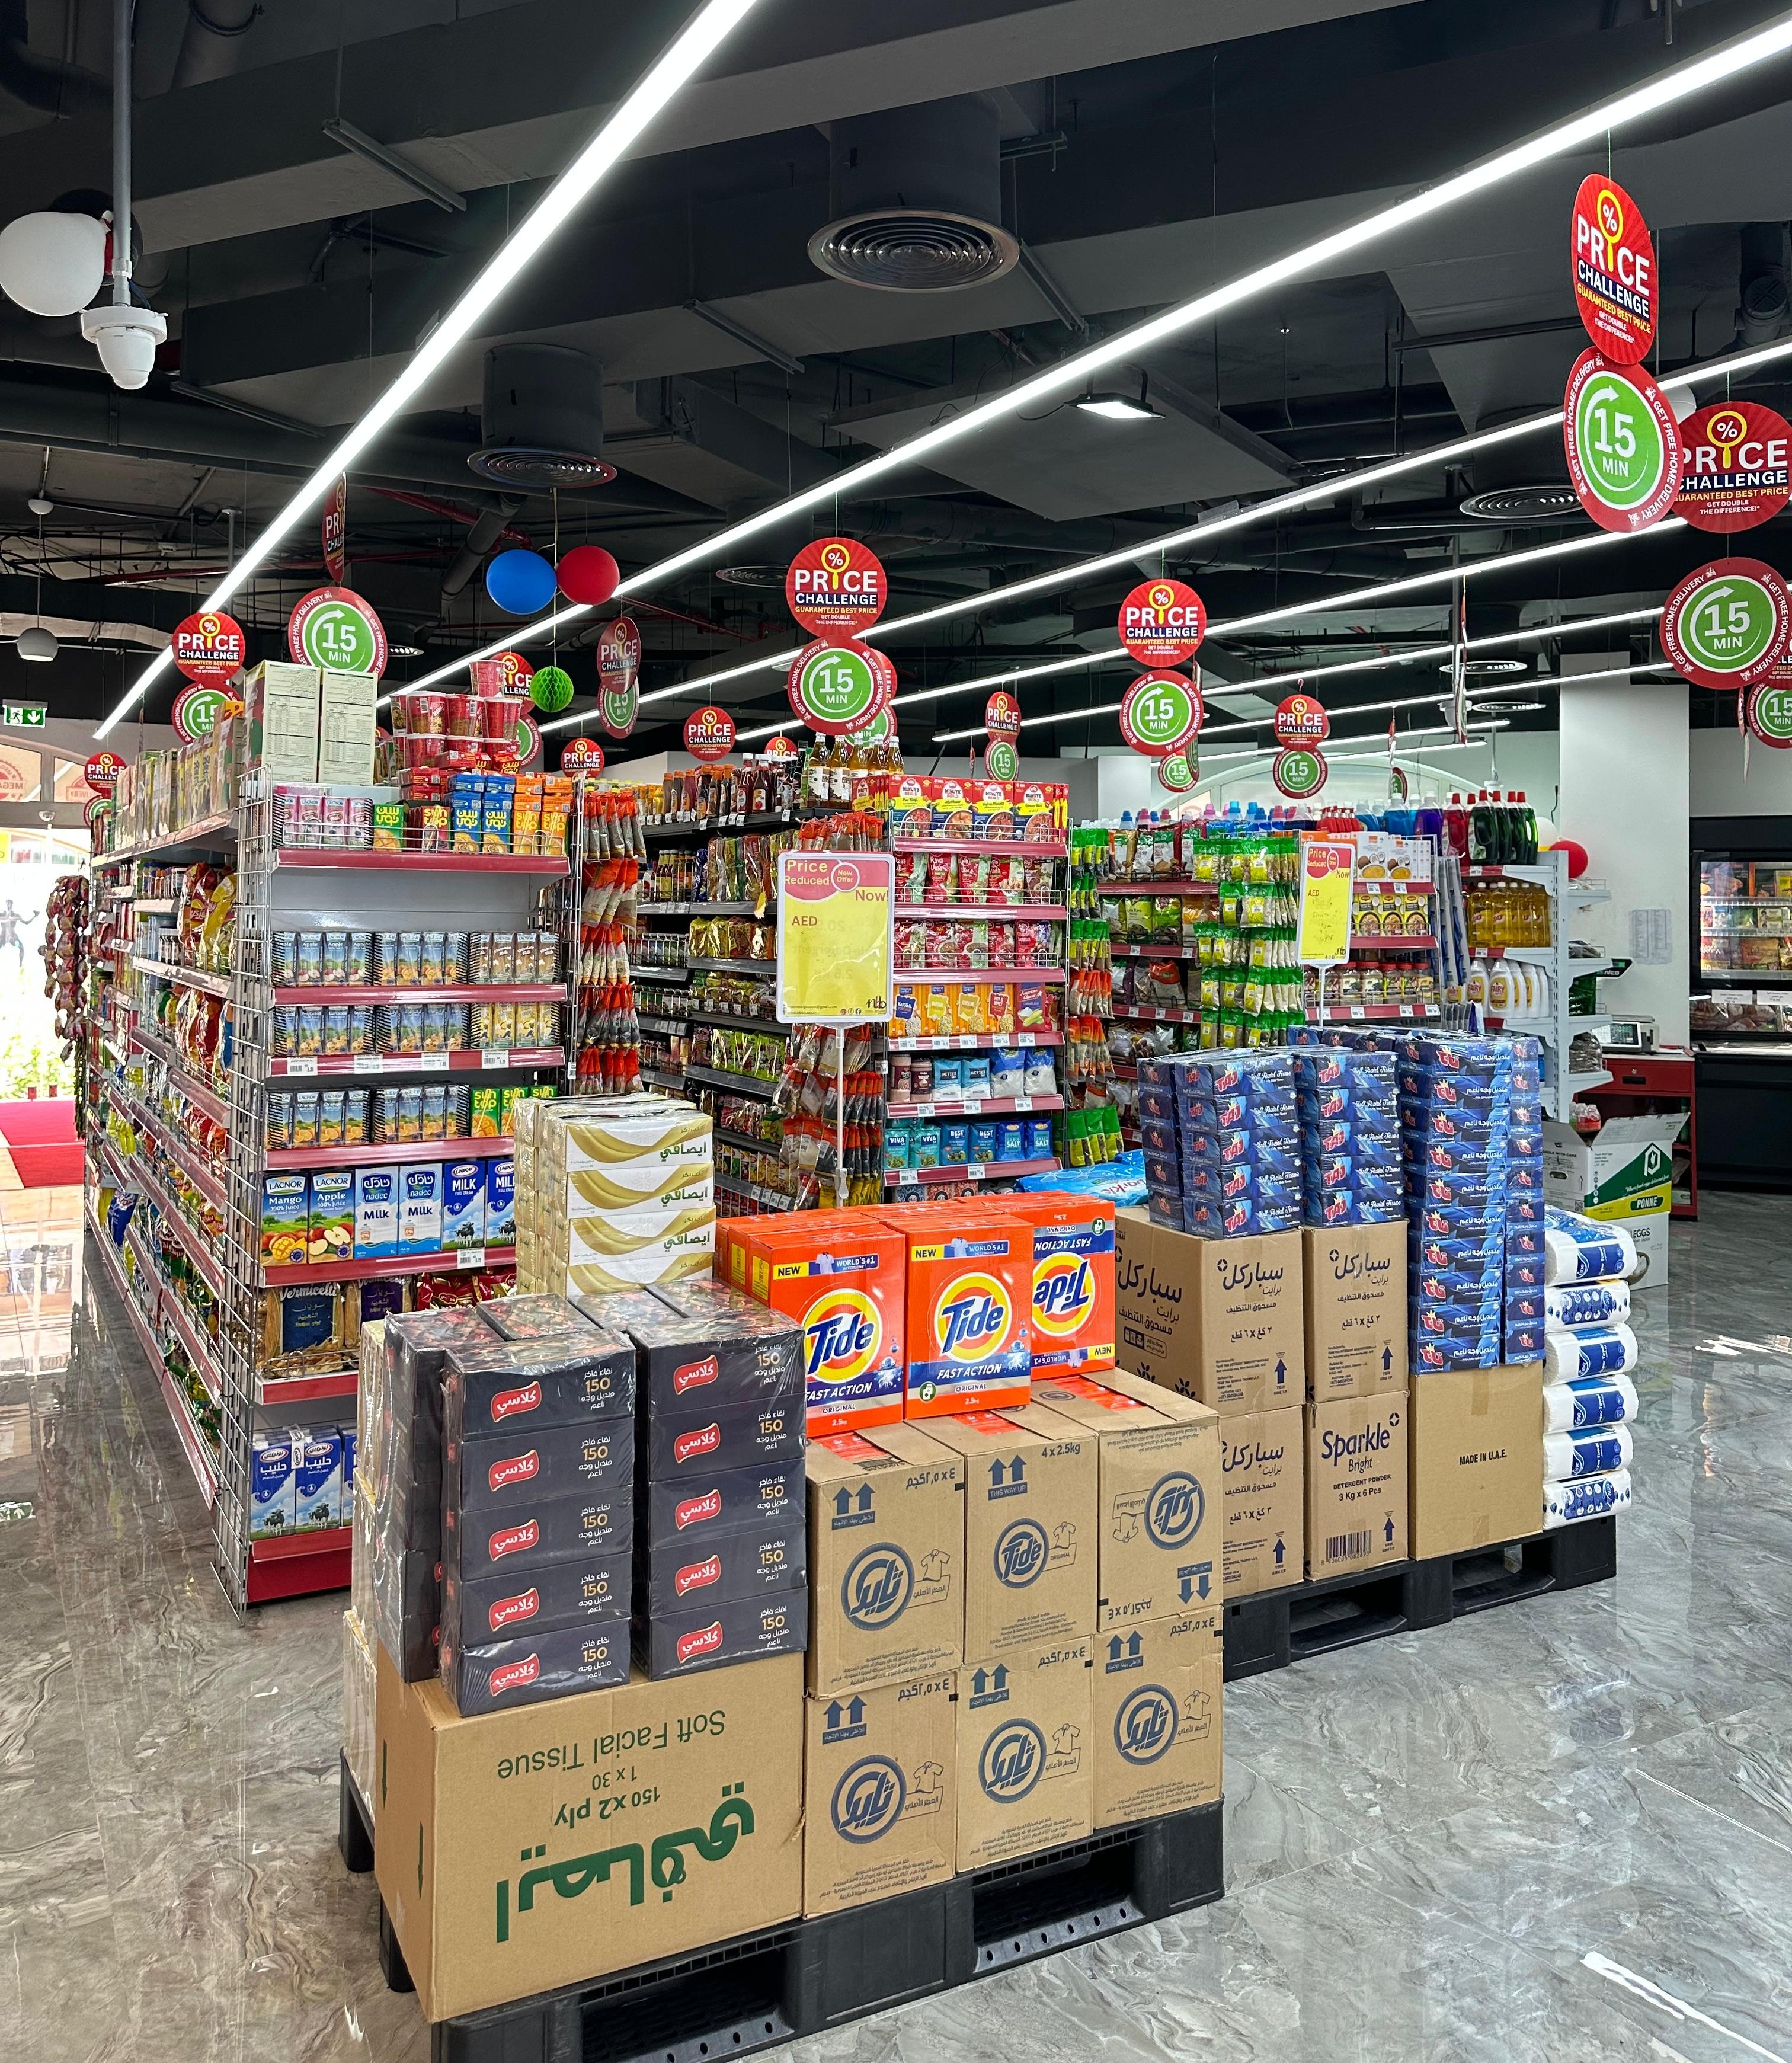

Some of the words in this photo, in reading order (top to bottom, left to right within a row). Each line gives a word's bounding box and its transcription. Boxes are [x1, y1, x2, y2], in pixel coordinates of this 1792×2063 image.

[1577, 213, 1649, 296] PRICE
[1578, 260, 1649, 319] CHALLENGE
[1577, 283, 1615, 315] GUARANTEED
[1617, 309, 1632, 324] BEST
[1633, 319, 1652, 334] PRICE
[1653, 401, 1668, 423] GET
[1595, 408, 1636, 458] 15
[1663, 422, 1676, 450] FREE
[1602, 456, 1629, 478] MIN
[1666, 451, 1678, 487] HOME
[1736, 490, 1759, 499] BEST
[1761, 487, 1788, 497] PRICE
[1643, 485, 1675, 522] DELIVERY
[795, 569, 878, 592] PRICE
[796, 593, 877, 605] CHALLENGE
[1126, 606, 1198, 626] PRICE
[1704, 601, 1750, 637] 15
[322, 622, 357, 652] 15
[1127, 627, 1197, 637] CHALLENGE
[178, 633, 239, 651] PRICE
[1714, 636, 1742, 650] MIN
[180, 650, 238, 660] CHALLENGE
[601, 639, 637, 660] PRICE
[329, 651, 350, 663] MIN
[602, 657, 636, 670] CHALLENGE
[819, 669, 854, 693] 15
[826, 695, 847, 704] MIN
[988, 708, 1018, 723] PRICE
[1144, 698, 1174, 720] 15
[1150, 721, 1168, 730] MIN
[1278, 713, 1323, 726] PRICE
[689, 724, 731, 736] PRICE
[564, 751, 600, 762] PRICE
[998, 754, 1010, 767] 15
[1289, 762, 1308, 776] 15
[516, 811, 537, 821] sun
[1308, 849, 1326, 858] Price
[787, 859, 828, 872] Price
[785, 876, 830, 885] Reduced
[855, 889, 889, 901] Now!
[792, 916, 818, 926] AED
[1215, 1069, 1239, 1092] TAJ
[475, 1090, 496, 1099] sun
[475, 1099, 496, 1109] top
[1321, 1095, 1343, 1117] TAJ
[660, 1142, 706, 1162] ايصافي
[270, 1181, 302, 1190] LACNOR
[316, 1177, 348, 1186] LACNOR
[452, 1178, 476, 1191] MILK
[317, 1192, 346, 1201] Apple
[366, 1192, 388, 1201] nadec
[410, 1189, 431, 1197] nadec
[661, 1186, 708, 1207] ايصافي
[269, 1197, 302, 1205] Mango
[1637, 1197, 1657, 1208] PONNE
[364, 1210, 389, 1220] Milk
[408, 1206, 433, 1217] Milk
[1633, 1228, 1650, 1238] EGGS
[664, 1231, 710, 1252] ايصافي
[969, 1243, 996, 1252] WORLD'S
[1034, 1239, 1068, 1251] ACTION
[1070, 1237, 1092, 1248] FAST
[915, 1248, 936, 1258] NEW
[837, 1256, 865, 1267] WORLD'S
[866, 1255, 875, 1265] #1
[777, 1266, 801, 1277] NEW
[1223, 1262, 1284, 1290] سباركل
[1033, 1260, 1090, 1314] Tide
[1118, 1260, 1182, 1303] سباركل
[279, 1283, 337, 1301] Vermicelli
[1263, 1284, 1282, 1297] برايت
[1226, 1304, 1252, 1314] التنظيف
[1252, 1302, 1276, 1312] مسحوق
[1119, 1306, 1144, 1325] التنظيف
[1157, 1306, 1179, 1325] برايت
[942, 1297, 1004, 1354] Tide
[1144, 1315, 1172, 1335] مسحوق
[807, 1313, 875, 1375] Tide
[1094, 1346, 1112, 1355] NEW
[757, 1352, 780, 1366] 150
[679, 1363, 713, 1386] كلاسي
[937, 1367, 962, 1380] FAST
[964, 1363, 1002, 1377] ACTION
[585, 1377, 610, 1392] 150
[956, 1384, 987, 1392] ORIGINAL
[805, 1387, 831, 1402] FAST
[831, 1382, 872, 1398] ACTION
[497, 1390, 536, 1413] كلاسي
[823, 1403, 855, 1414] ORIGINAL
[1041, 1447, 1048, 1458] 4
[1049, 1448, 1055, 1457] x
[1057, 1442, 1081, 1456] 2.5kg
[1321, 1422, 1390, 1467] Sparkle
[306, 1456, 332, 1469] حليب
[1459, 1454, 1478, 1465] MADE
[1480, 1452, 1487, 1462] IN
[1489, 1449, 1507, 1460] U.A.E.
[261, 1462, 287, 1475] حليب
[1348, 1456, 1372, 1473] Bright
[1333, 1478, 1367, 1490] DETERGENT
[1368, 1474, 1391, 1483] POWDER
[761, 1485, 784, 1499] 150
[990, 1489, 1003, 1498] THIS
[1339, 1493, 1343, 1501] 3
[1346, 1491, 1355, 1501] Kg
[581, 1507, 595, 1517] فاخر
[597, 1504, 610, 1512] نقاء
[681, 1498, 716, 1521] كلاسي
[583, 1514, 608, 1528] 150
[578, 1530, 592, 1539] وجه
[594, 1527, 612, 1536] منديل
[494, 1528, 533, 1551] كلاسي
[588, 1537, 603, 1546] ناعم
[1001, 1536, 1042, 1581] Tide
[1050, 1552, 1070, 1560] ORIGINAL
[677, 1710, 725, 1743] Soft
[594, 1722, 668, 1763] Facial
[497, 1743, 584, 1779] Tissue
[616, 1768, 625, 1781] x
[631, 1766, 637, 1781] 1
[592, 1773, 610, 1790] 30
[553, 1798, 591, 1829] ply
[599, 1795, 627, 1819] x2
[497, 1781, 755, 1943] ايصافي
